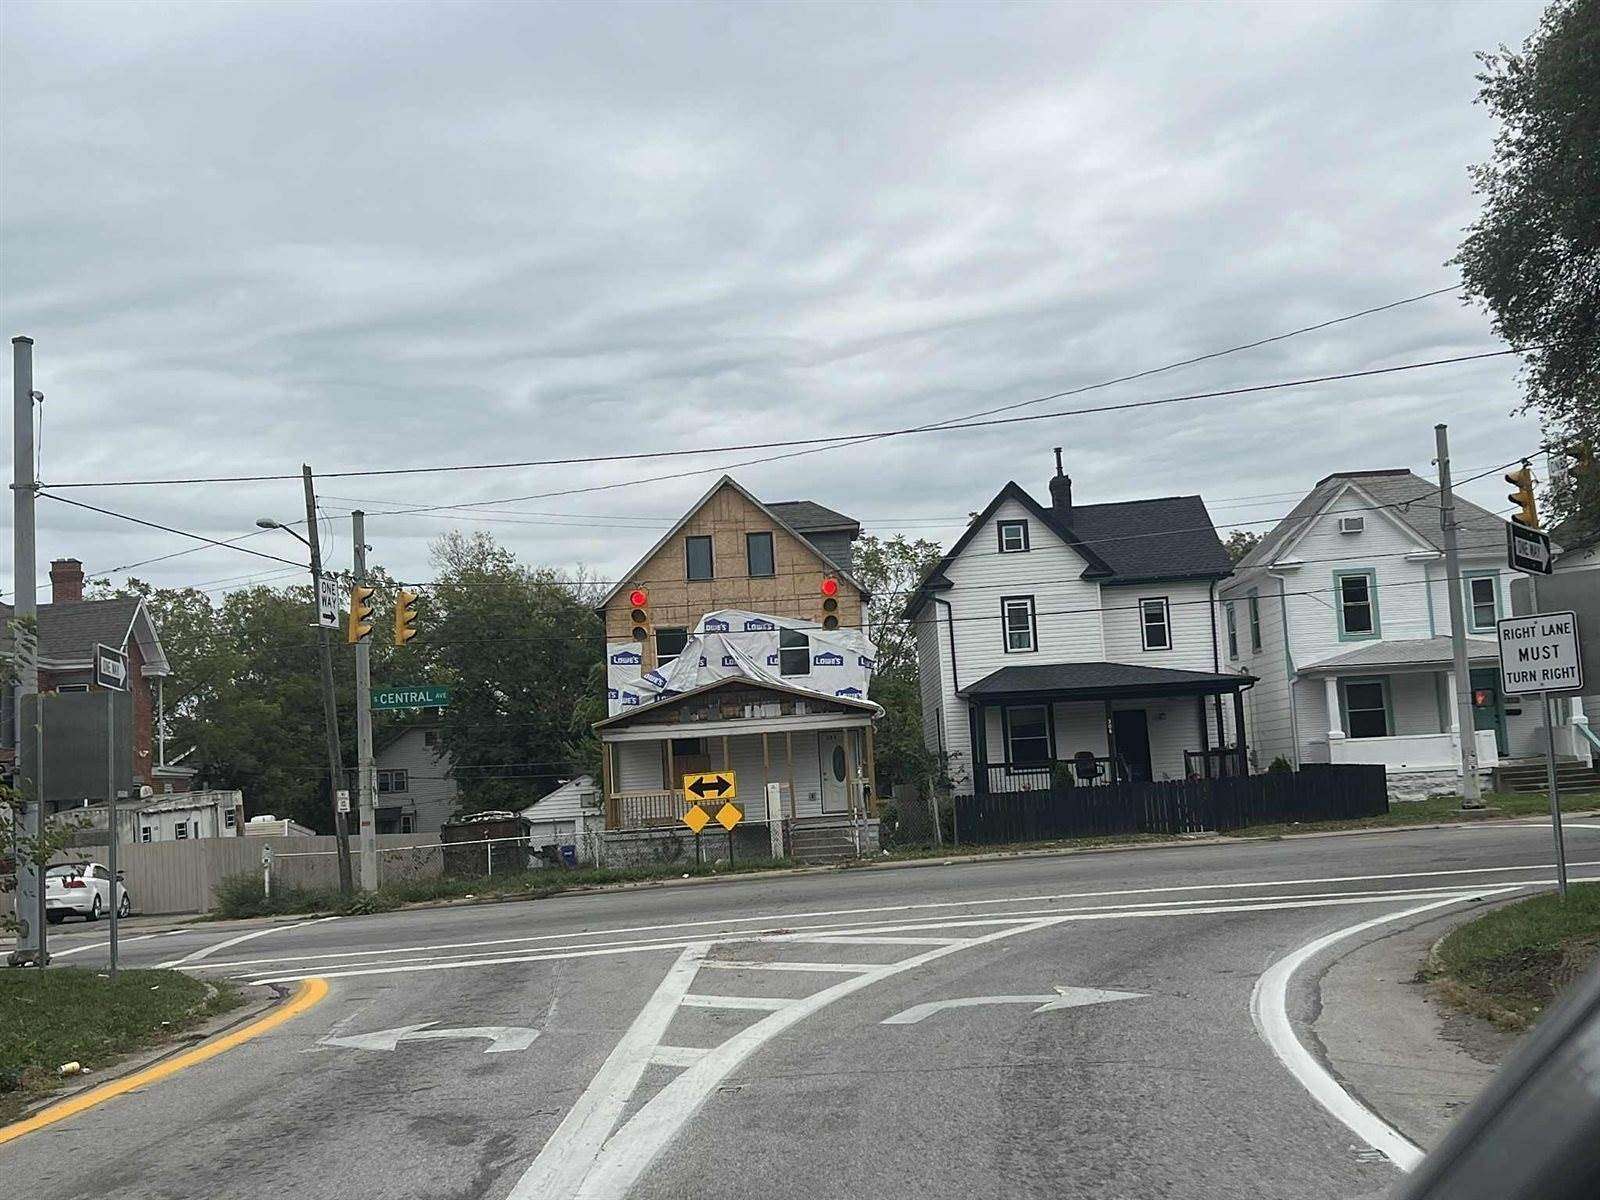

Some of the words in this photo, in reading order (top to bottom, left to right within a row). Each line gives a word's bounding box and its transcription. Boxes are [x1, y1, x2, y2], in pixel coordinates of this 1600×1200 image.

[321, 581, 336, 596] ONE
[322, 596, 336, 610] WAY
[1503, 626, 1537, 641] RIGHT
[1542, 622, 1571, 637] LANE
[1518, 644, 1560, 663] MUST
[1507, 672, 1537, 684] TURN
[1542, 666, 1577, 681] RIGHT
[380, 691, 433, 704] CENTRAL
[435, 691, 447, 699] AVE
